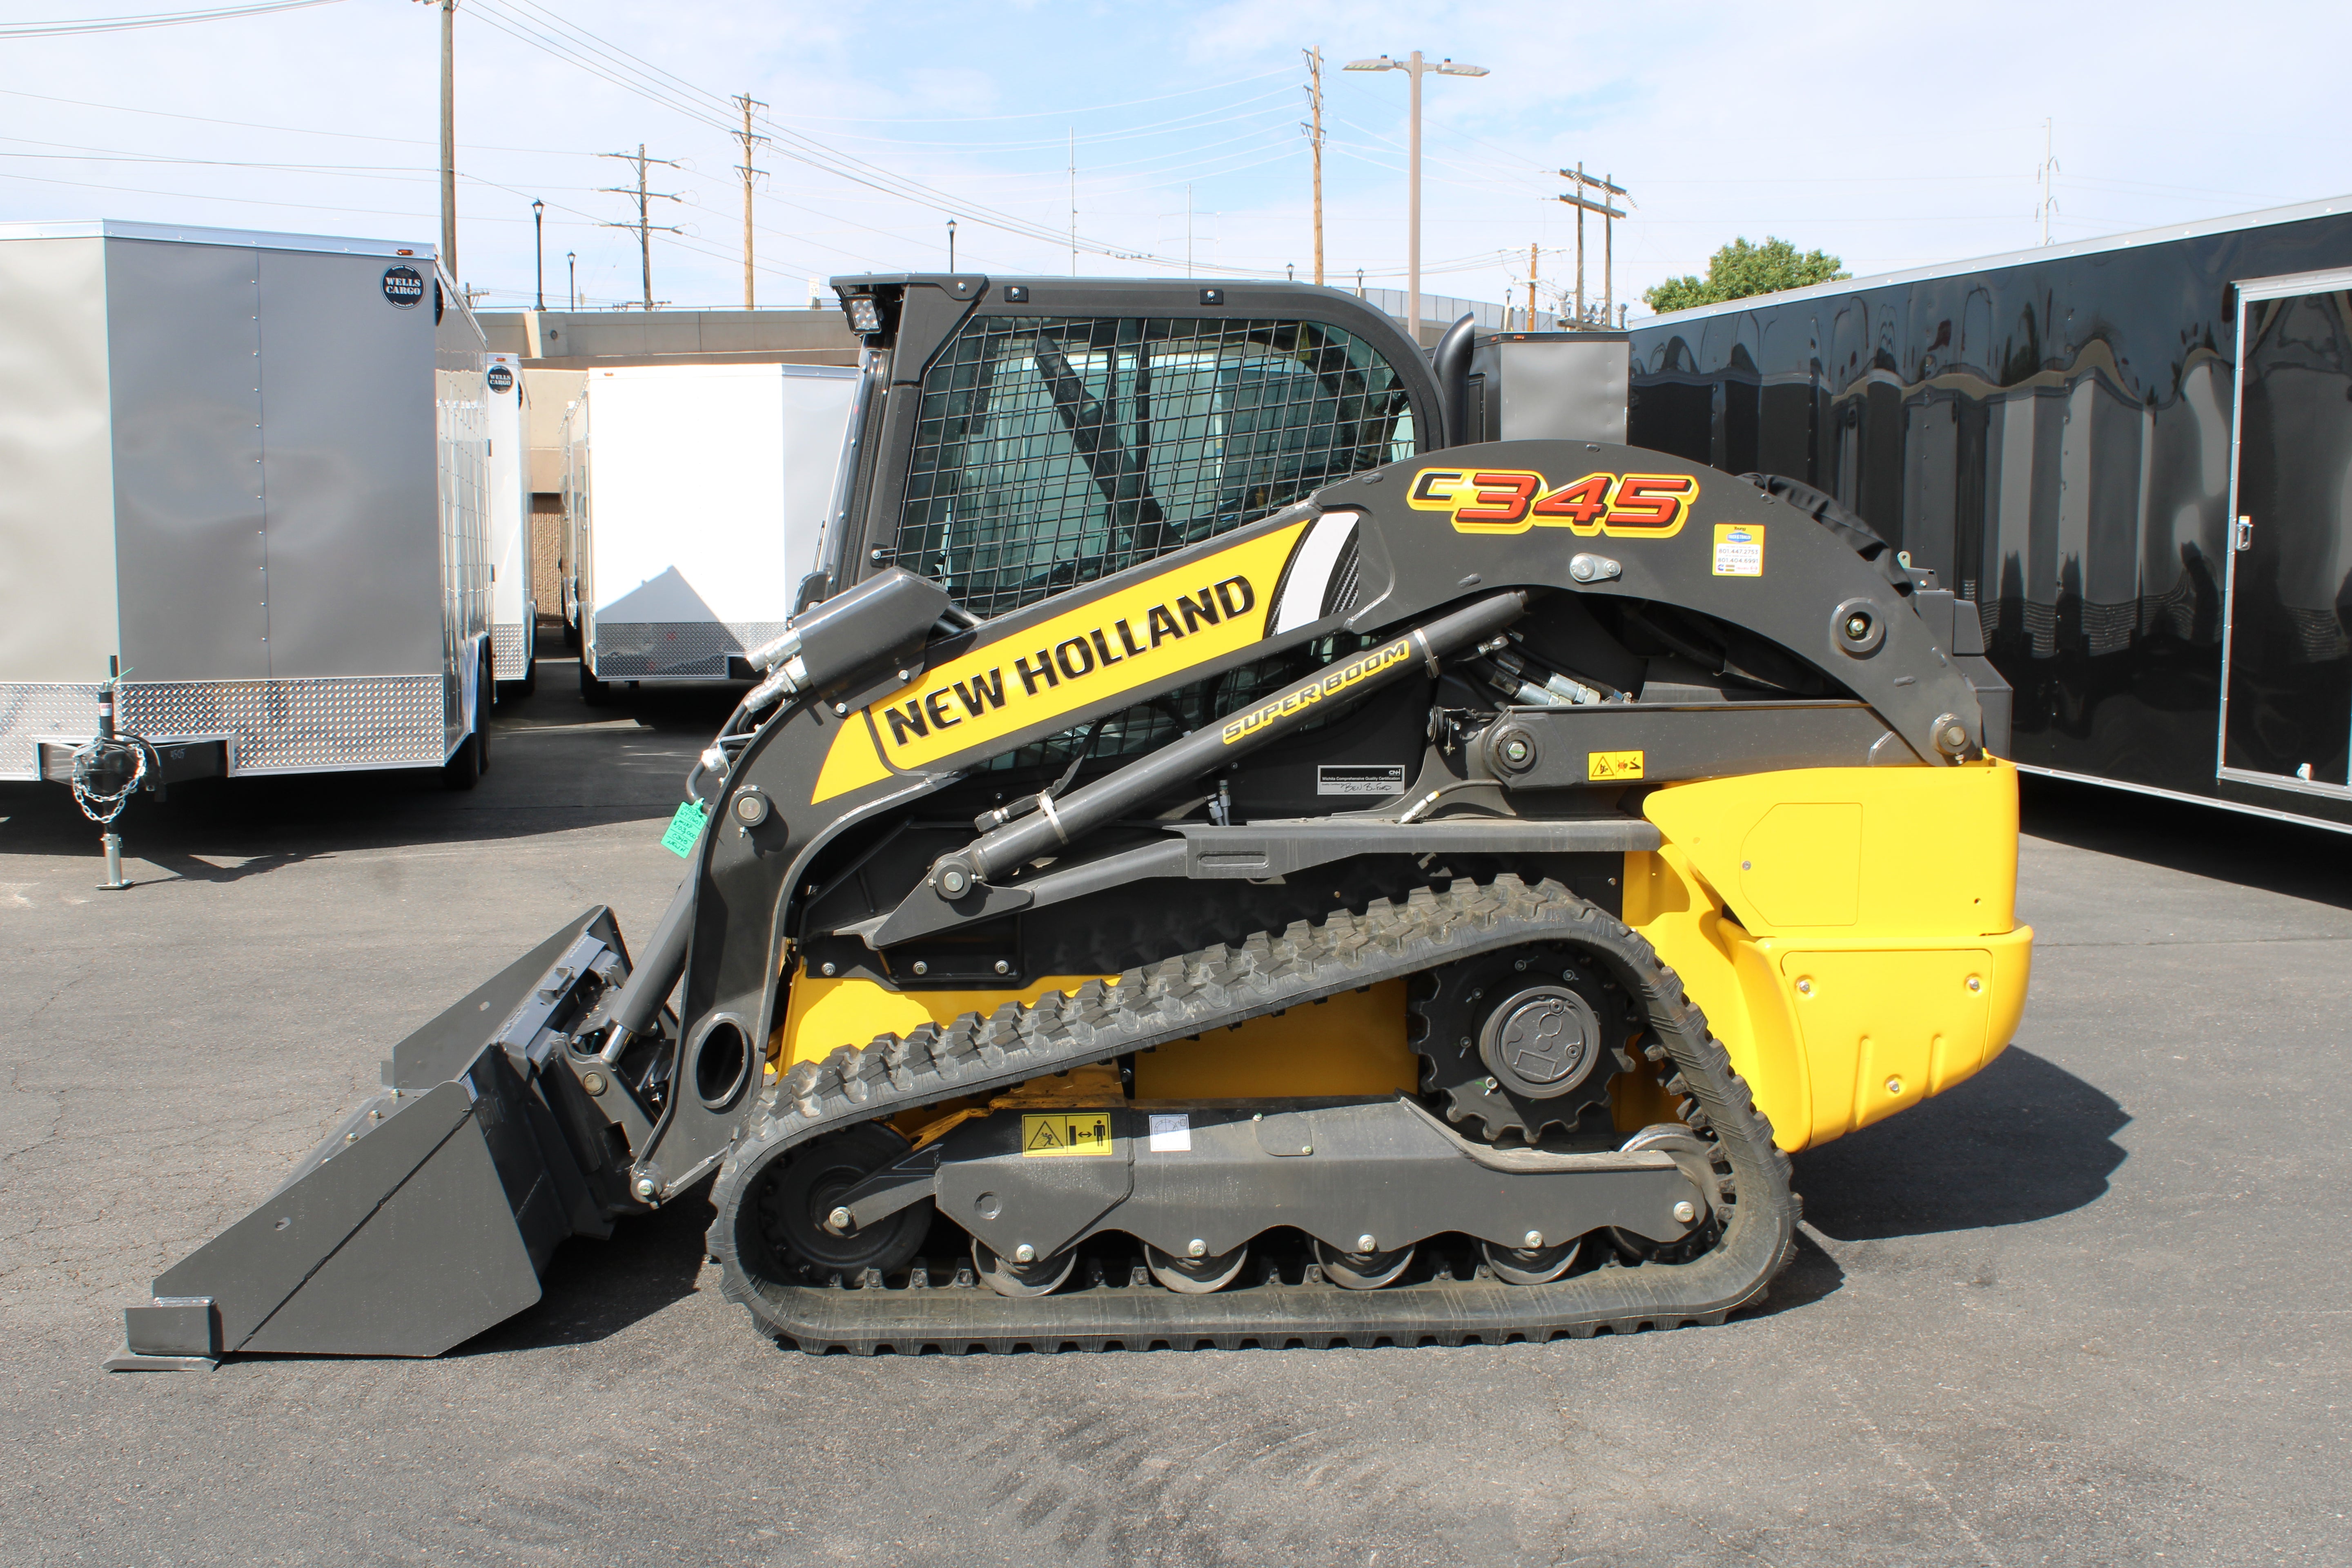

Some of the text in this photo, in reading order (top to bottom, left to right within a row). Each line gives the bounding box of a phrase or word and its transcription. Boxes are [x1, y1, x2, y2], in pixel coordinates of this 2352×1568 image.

[385, 277, 421, 287] WELLS
[385, 286, 421, 295] CARGO
[1409, 470, 1695, 532] C345
[883, 573, 1256, 748] NEW HOLLAND
[1223, 640, 1410, 745] SUPER BOOM
[672, 833, 688, 844] C345
